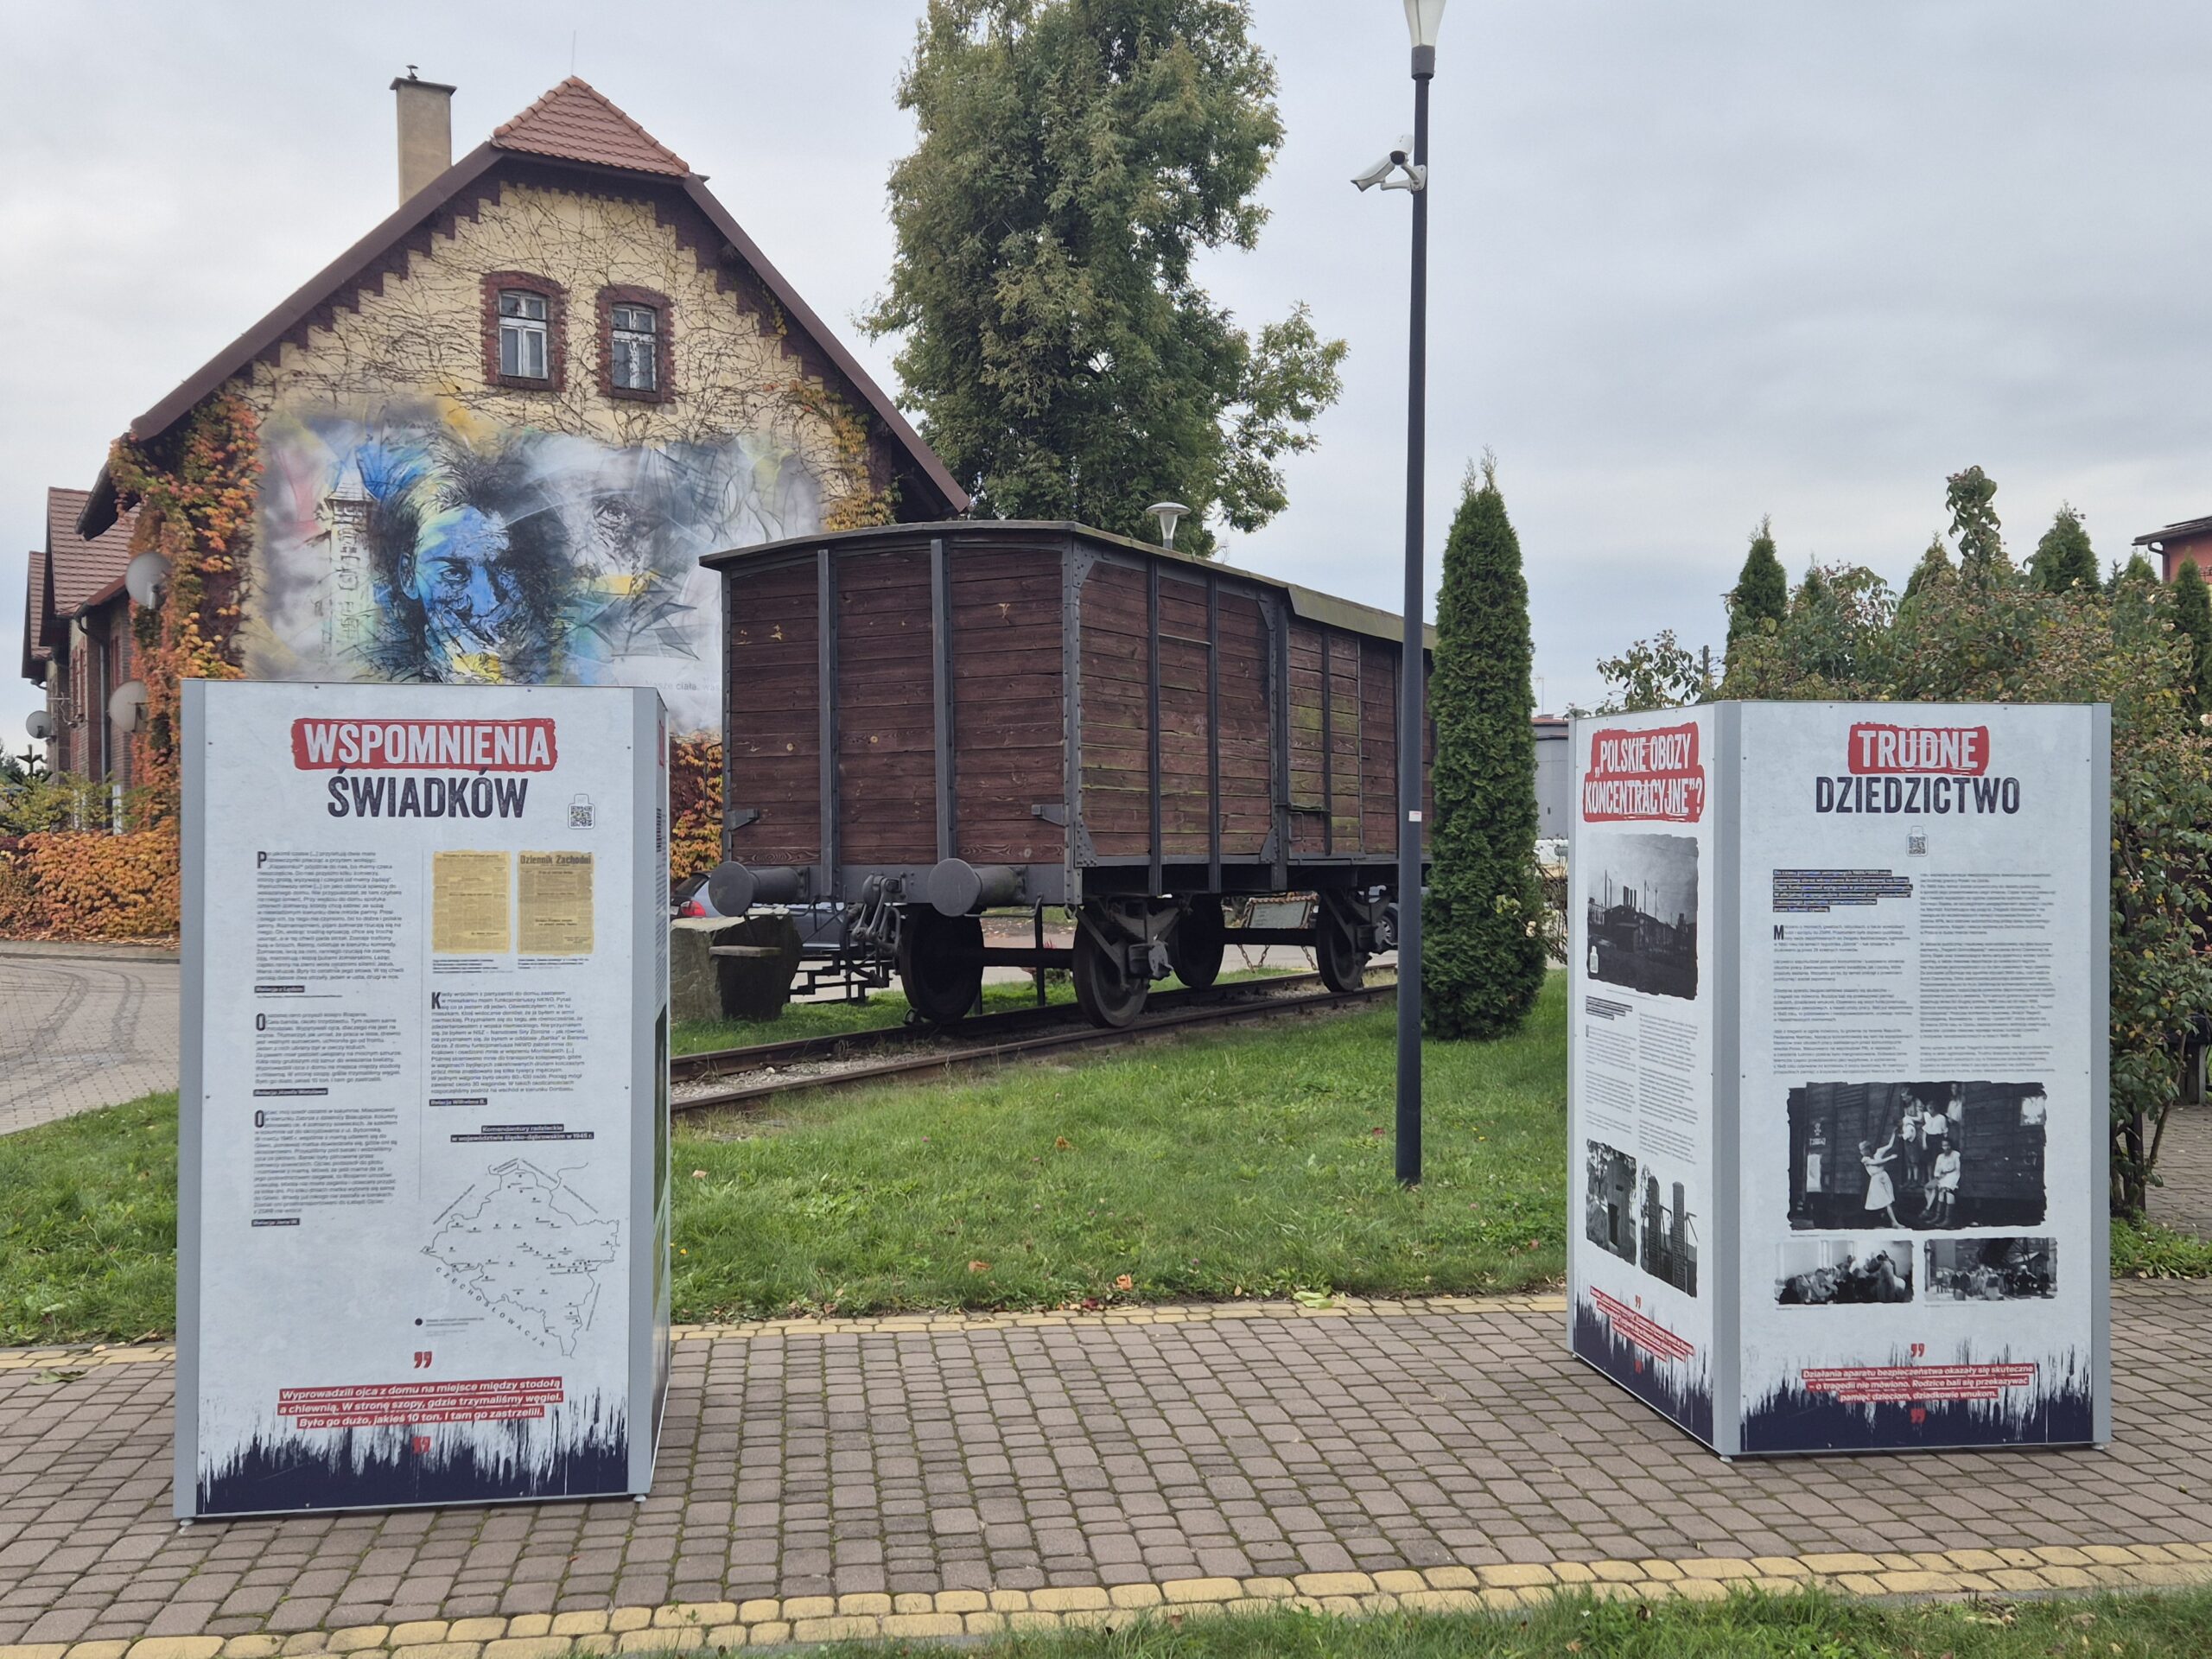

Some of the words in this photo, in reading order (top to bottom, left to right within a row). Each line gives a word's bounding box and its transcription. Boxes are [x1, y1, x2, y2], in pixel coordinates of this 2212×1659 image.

[304, 723, 550, 765] WSPOMNIENIA
[1858, 730, 1978, 768] TRUDNE
[1595, 736, 1646, 778] „POLSKIE
[1650, 734, 1691, 772] OBOZY
[327, 766, 529, 817] ŚWIADKÓW
[1585, 778, 1703, 815] KONCENTRACYJNE”?
[1815, 776, 2020, 814] DZIEDZICTWO
[520, 855, 553, 864] Dziennik
[556, 855, 591, 864] Zachodni
[1803, 1370, 1842, 1378] Działania
[1843, 1369, 1876, 1379] aparatu
[1877, 1367, 1943, 1378] bezpieczeństwa
[1944, 1366, 1976, 1375] okazały
[1978, 1365, 1990, 1375] się
[1823, 1382, 1856, 1391] tragedii
[1871, 1380, 1910, 1389] mówiono.
[1912, 1379, 1945, 1388] Rodzice
[1962, 1378, 1974, 1388] się
[1975, 1376, 2028, 1387] przekazywać
[282, 1389, 353, 1402] Wyprowadzili
[355, 1388, 378, 1398] ojca
[389, 1385, 419, 1395] domu
[436, 1383, 476, 1395] miejsce
[480, 1381, 518, 1392] między
[519, 1379, 561, 1390] stodołą
[1840, 1393, 1870, 1402] pamięć
[1872, 1392, 1911, 1401] dzieciom,
[289, 1404, 340, 1414] chlewnią.
[354, 1402, 390, 1412] stronę
[391, 1400, 425, 1411] szopy,
[427, 1398, 457, 1408] gdzie
[459, 1394, 523, 1406] trzymaliśmy
[525, 1393, 562, 1404] węgiel.
[299, 1418, 324, 1428] Było
[327, 1418, 340, 1427] go
[342, 1415, 372, 1426] dużo,
[372, 1414, 405, 1426] jakieś
[407, 1414, 419, 1422] 10
[422, 1412, 442, 1421] ton.
[450, 1411, 472, 1420] tam
[474, 1411, 487, 1421] go
[489, 1408, 543, 1418] zastrzelili.
